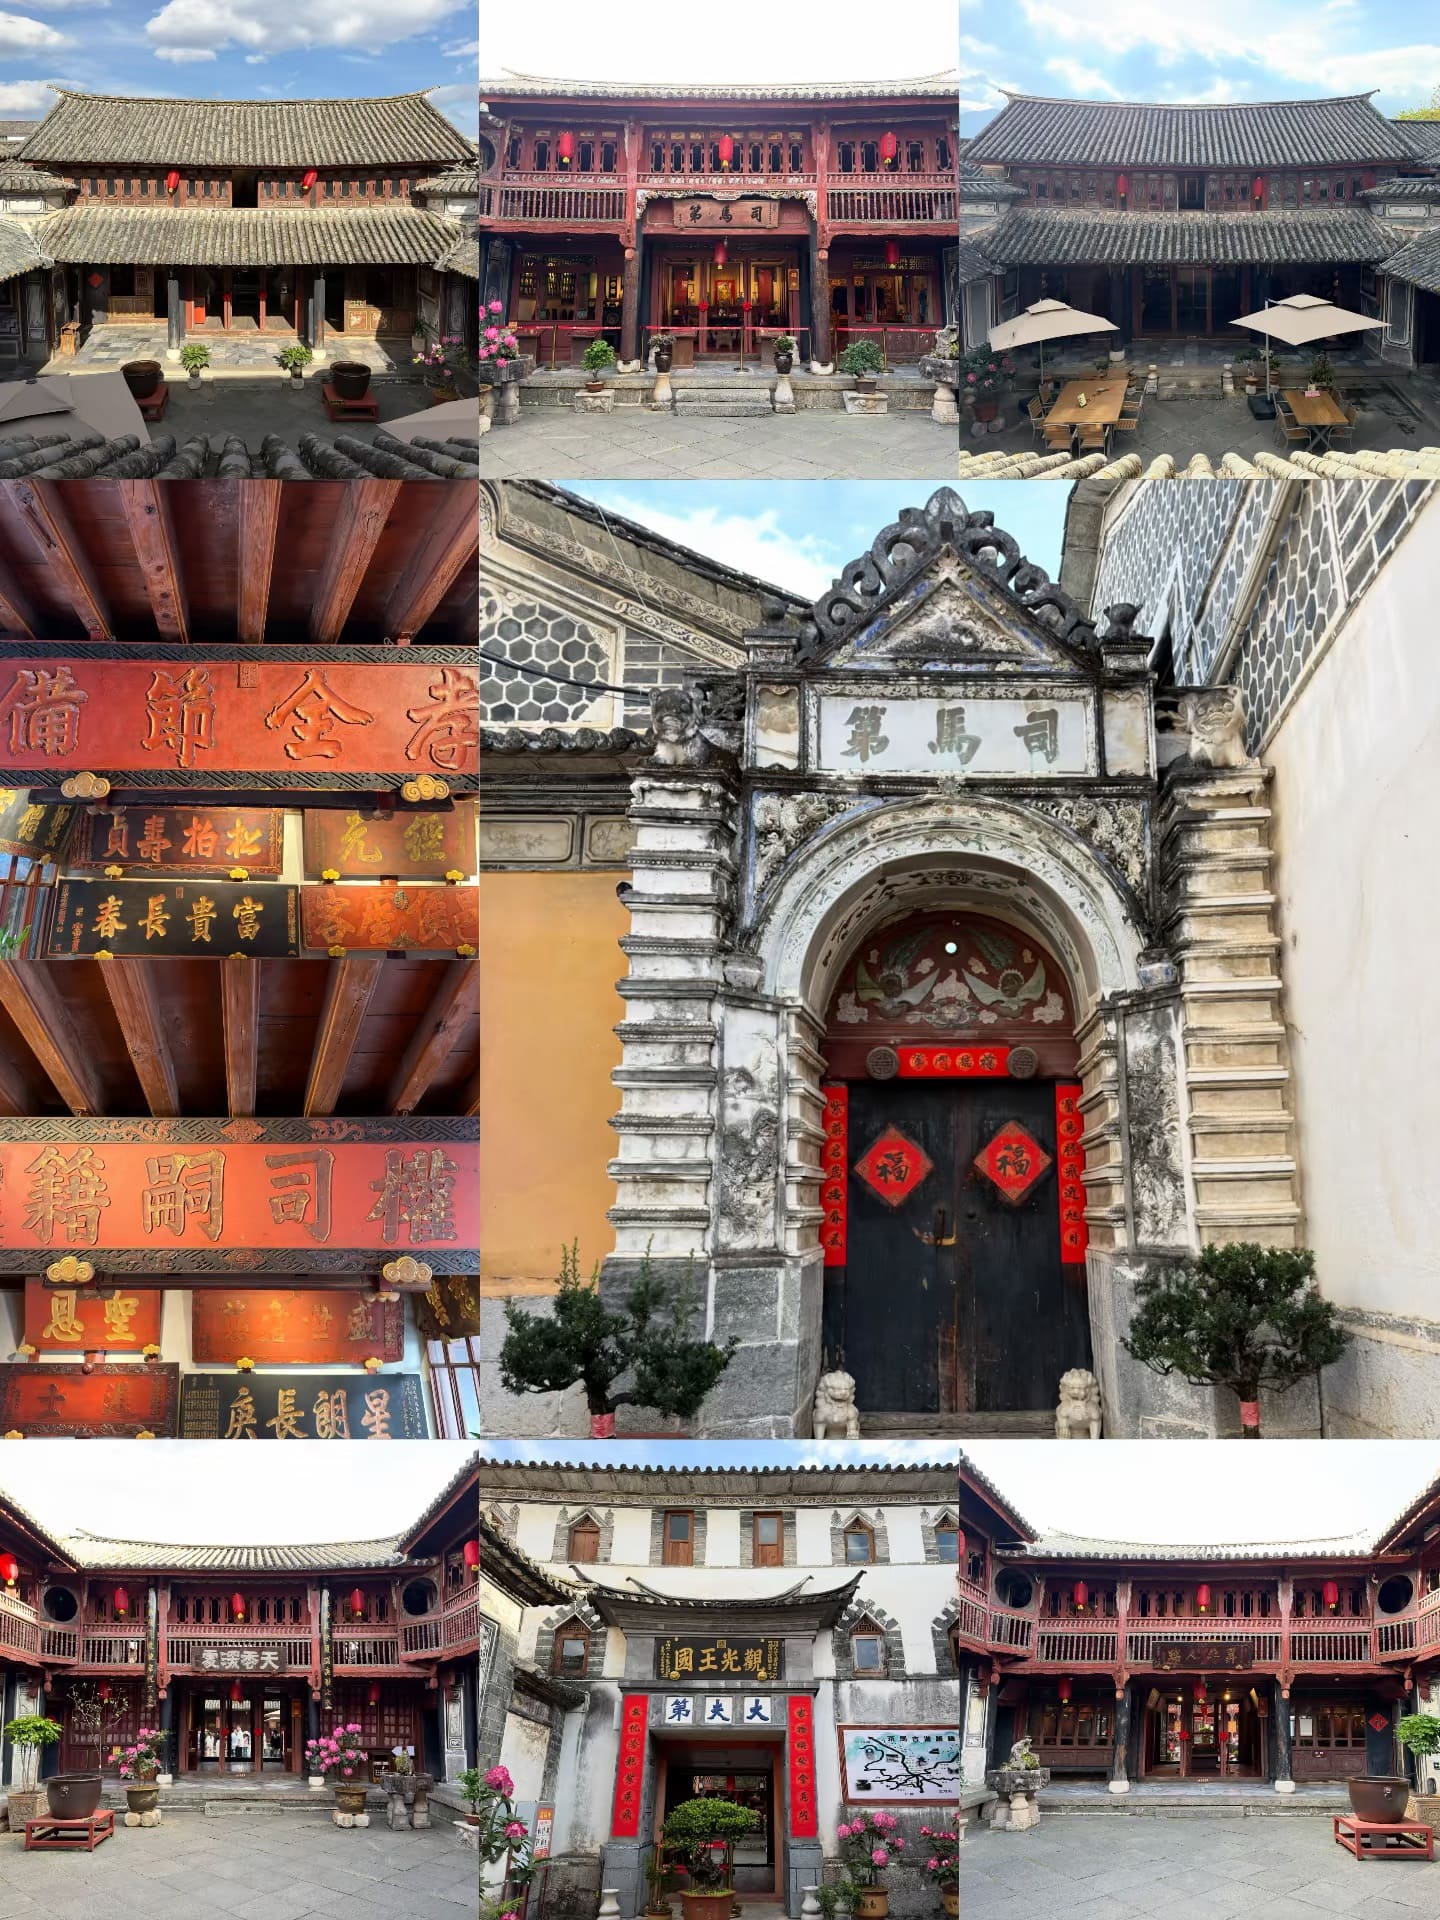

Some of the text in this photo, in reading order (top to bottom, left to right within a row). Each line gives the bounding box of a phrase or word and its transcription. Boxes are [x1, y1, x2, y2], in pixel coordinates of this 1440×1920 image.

[689, 203, 763, 224] 司馬第
[1, 665, 479, 769] 孝全節備
[839, 704, 1060, 766] 司馬第
[102, 814, 263, 863] 松柏壽貞
[91, 893, 264, 943] 富貴長春
[874, 1151, 910, 1185] 福
[996, 1144, 1031, 1178] 福
[22, 1145, 460, 1246] 權司嗣籍
[42, 1290, 140, 1342] 聖恩
[224, 1385, 392, 1439] 星朗長庚
[673, 1647, 766, 1673] 觀光王國
[667, 1697, 770, 1722] 大夫第
